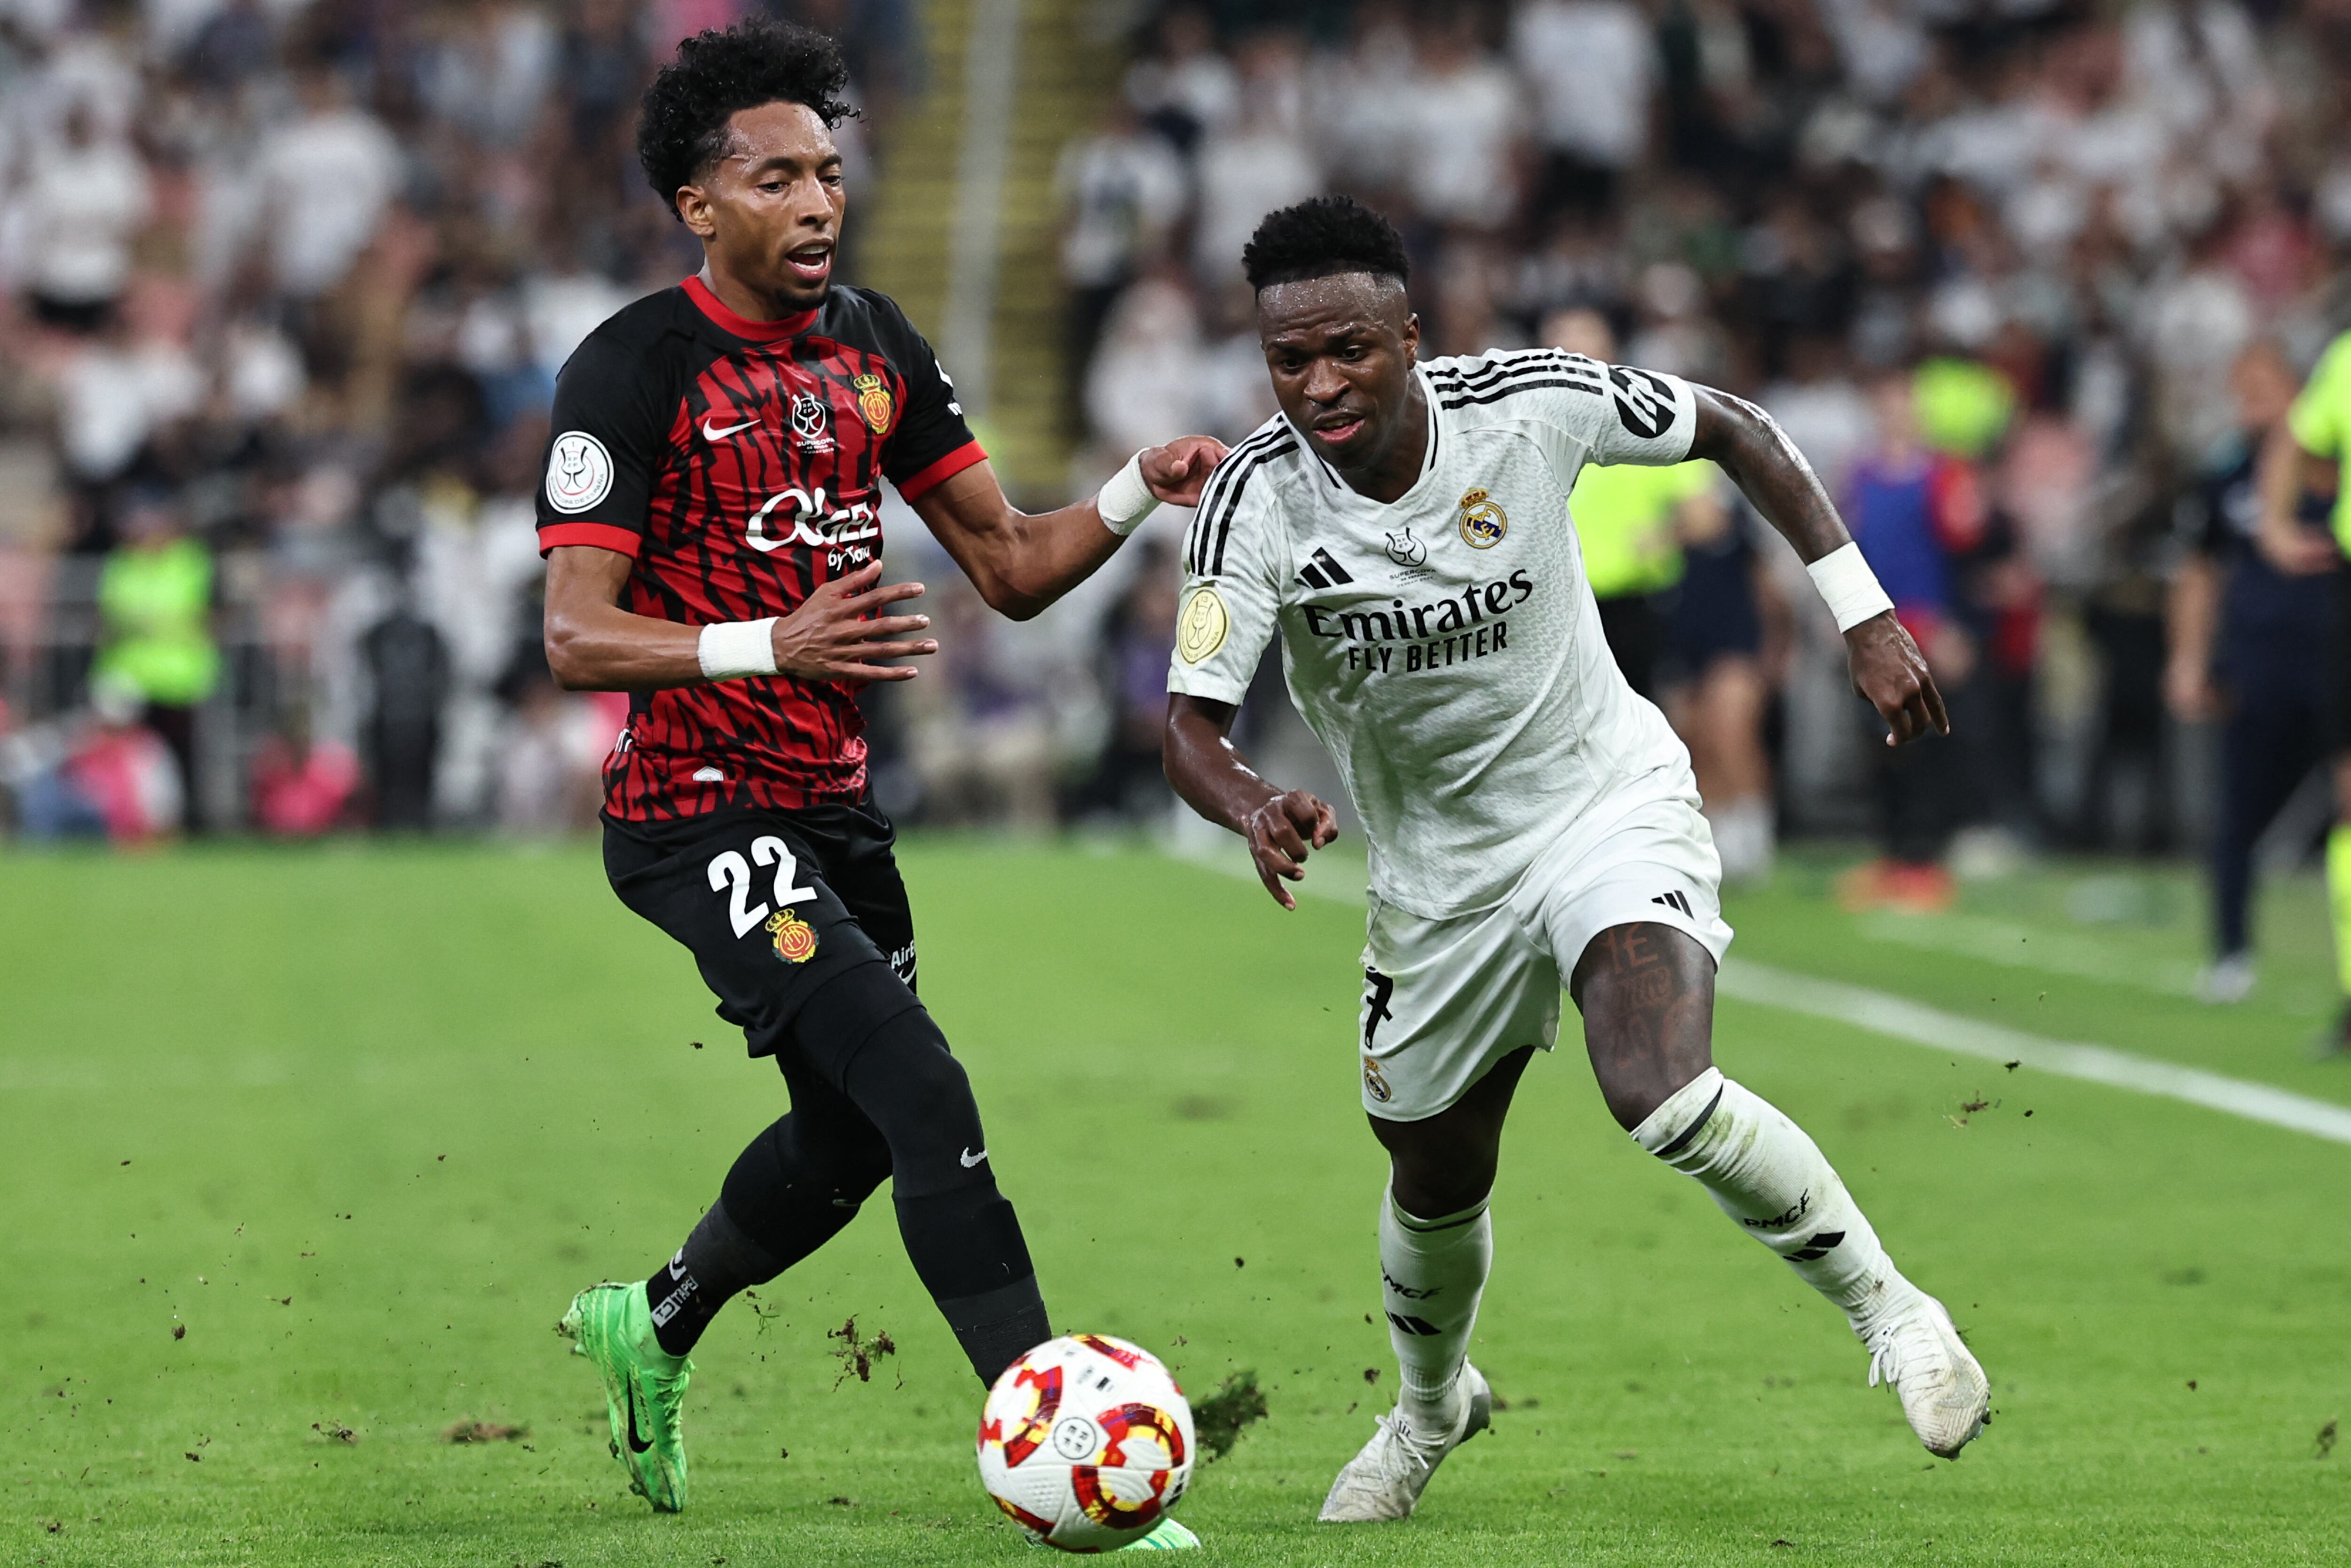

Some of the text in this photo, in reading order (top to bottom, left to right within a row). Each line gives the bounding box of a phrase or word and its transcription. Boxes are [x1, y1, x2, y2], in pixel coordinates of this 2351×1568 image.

[828, 547, 847, 571] by
[1300, 568, 1533, 642] Emirates
[1348, 621, 1507, 674] FLY BETTER
[707, 835, 818, 939] 22
[1365, 966, 1393, 1050] 7
[1381, 1260, 1444, 1300] MCF
